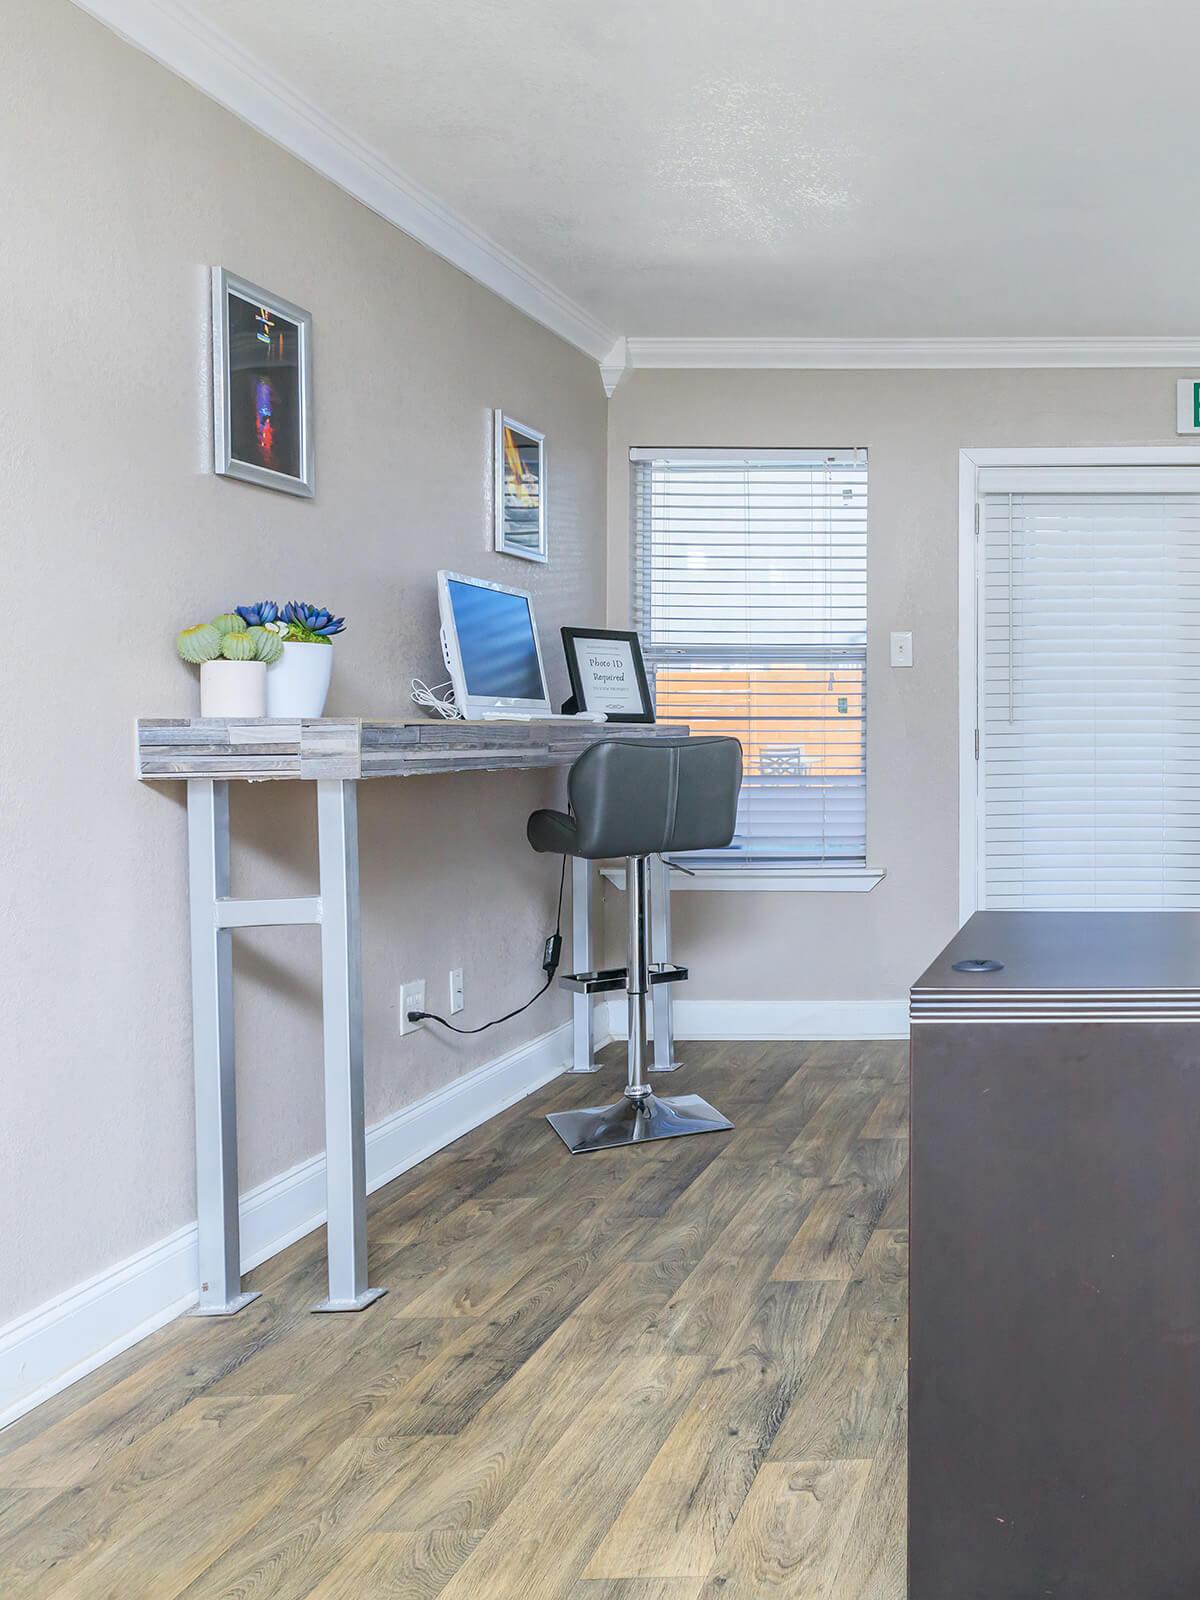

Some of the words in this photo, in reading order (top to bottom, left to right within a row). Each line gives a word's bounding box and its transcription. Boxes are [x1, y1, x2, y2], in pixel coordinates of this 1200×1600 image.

[590, 657, 611, 667] Photo
[612, 659, 623, 668] ID
[594, 672, 624, 684] Required
